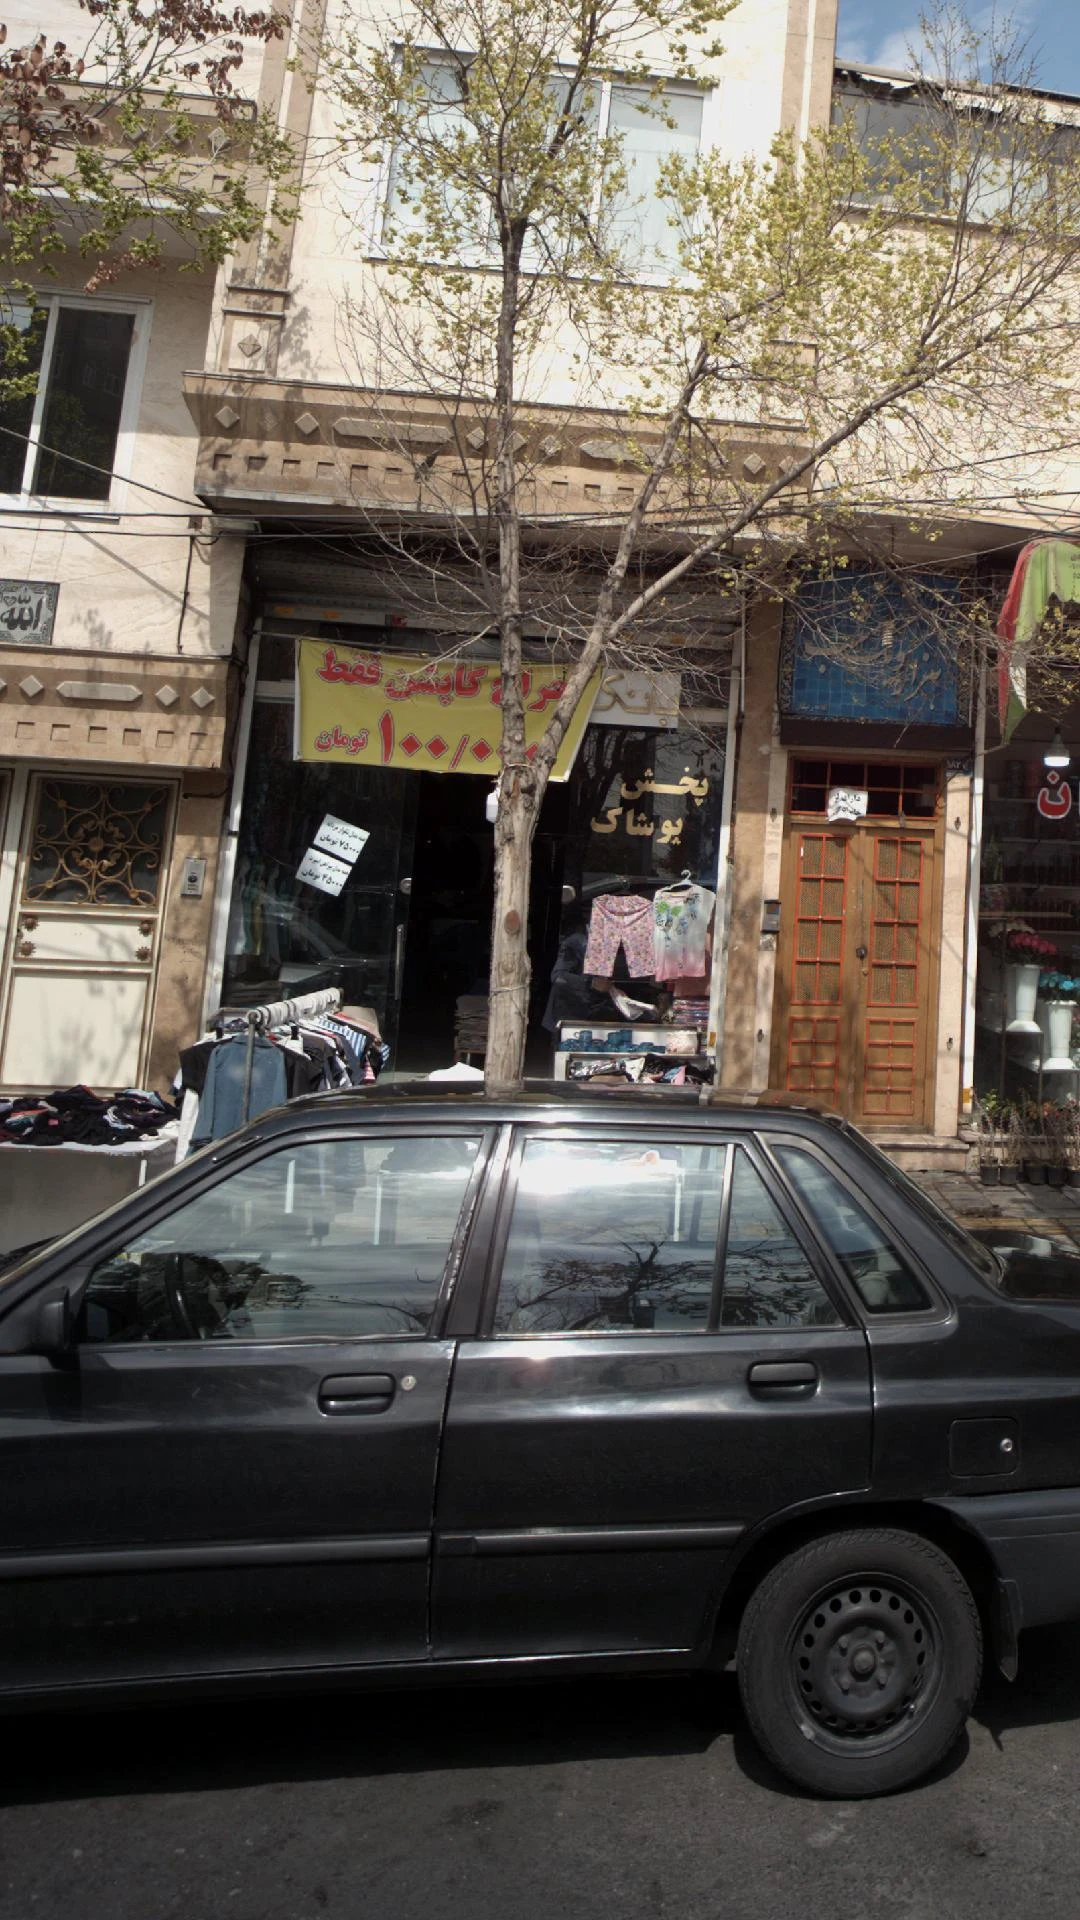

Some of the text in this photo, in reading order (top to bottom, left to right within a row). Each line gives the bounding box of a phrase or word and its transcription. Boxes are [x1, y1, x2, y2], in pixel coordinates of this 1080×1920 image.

[316, 647, 382, 687] فقط
[385, 664, 487, 706] کاپشن
[315, 709, 539, 770] ۱۰۰/۰۰ تومان
[620, 766, 709, 807] پخش
[319, 834, 338, 846] تومان
[590, 806, 684, 845] پوشاک
